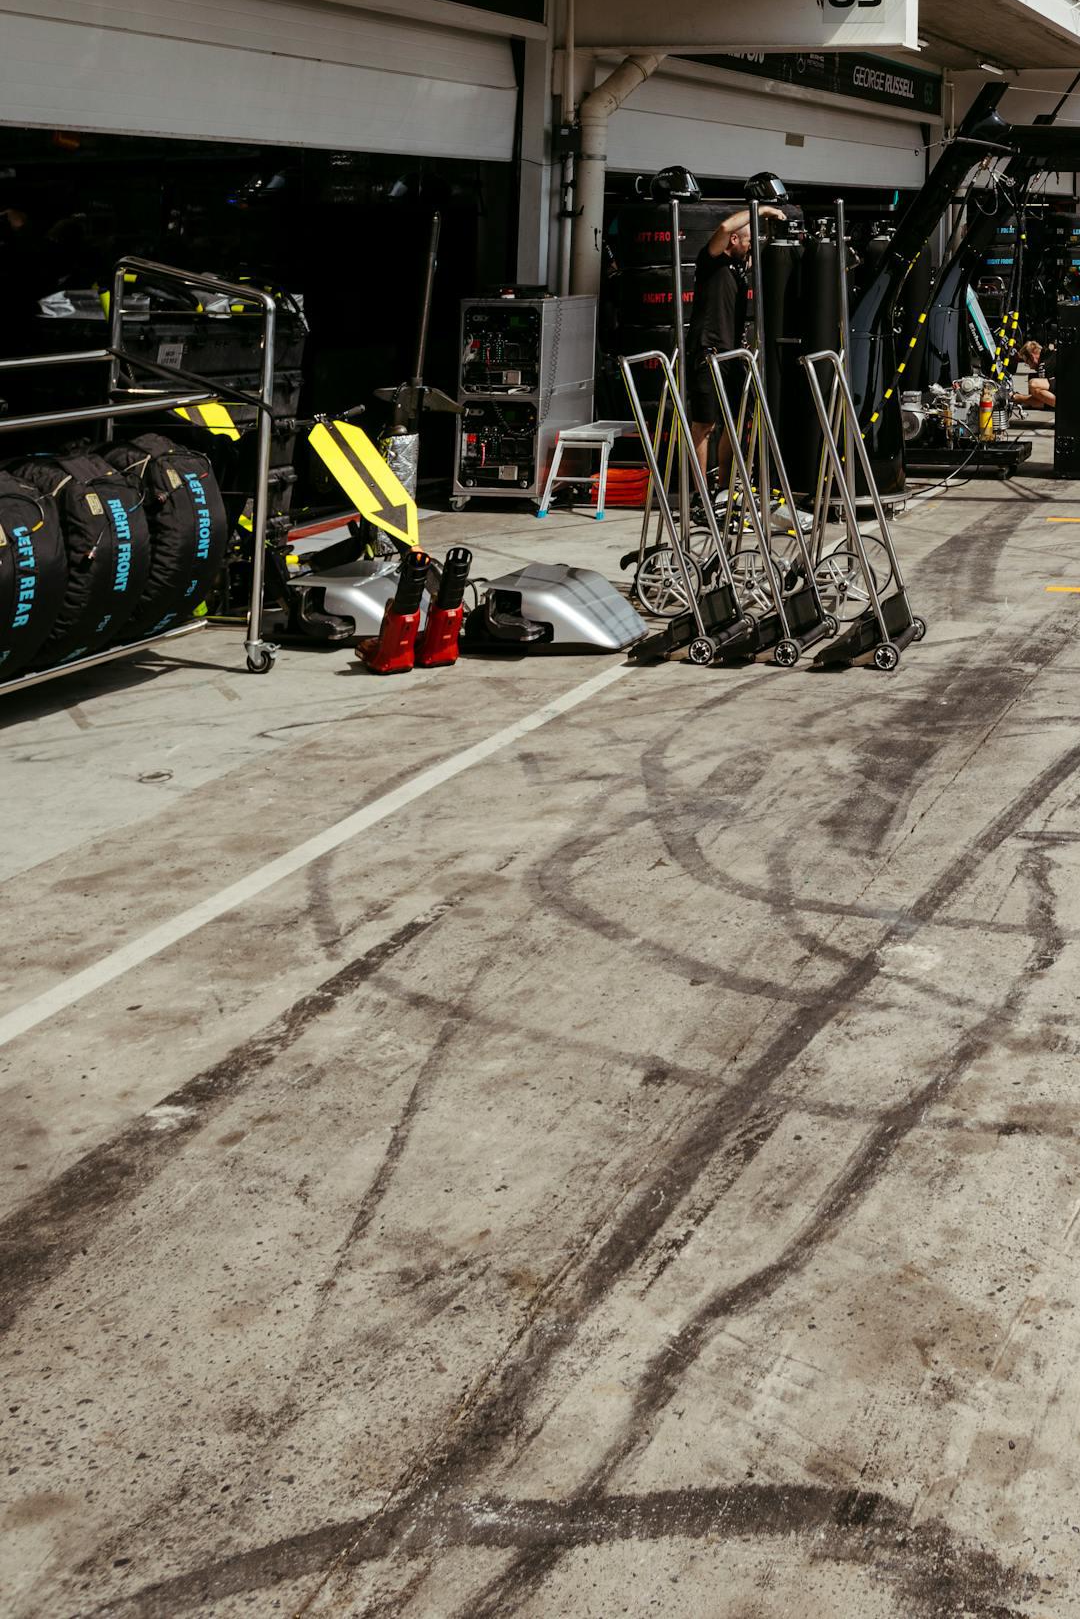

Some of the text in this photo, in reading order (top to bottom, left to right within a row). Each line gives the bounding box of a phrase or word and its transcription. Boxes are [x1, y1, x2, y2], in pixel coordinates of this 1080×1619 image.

[853, 65, 915, 99] GEORGE RUSSELL
[106, 498, 132, 592] RIGHT FRONT
[184, 472, 213, 560] LEFT FRONT
[11, 525, 36, 628] LEFT REAR
